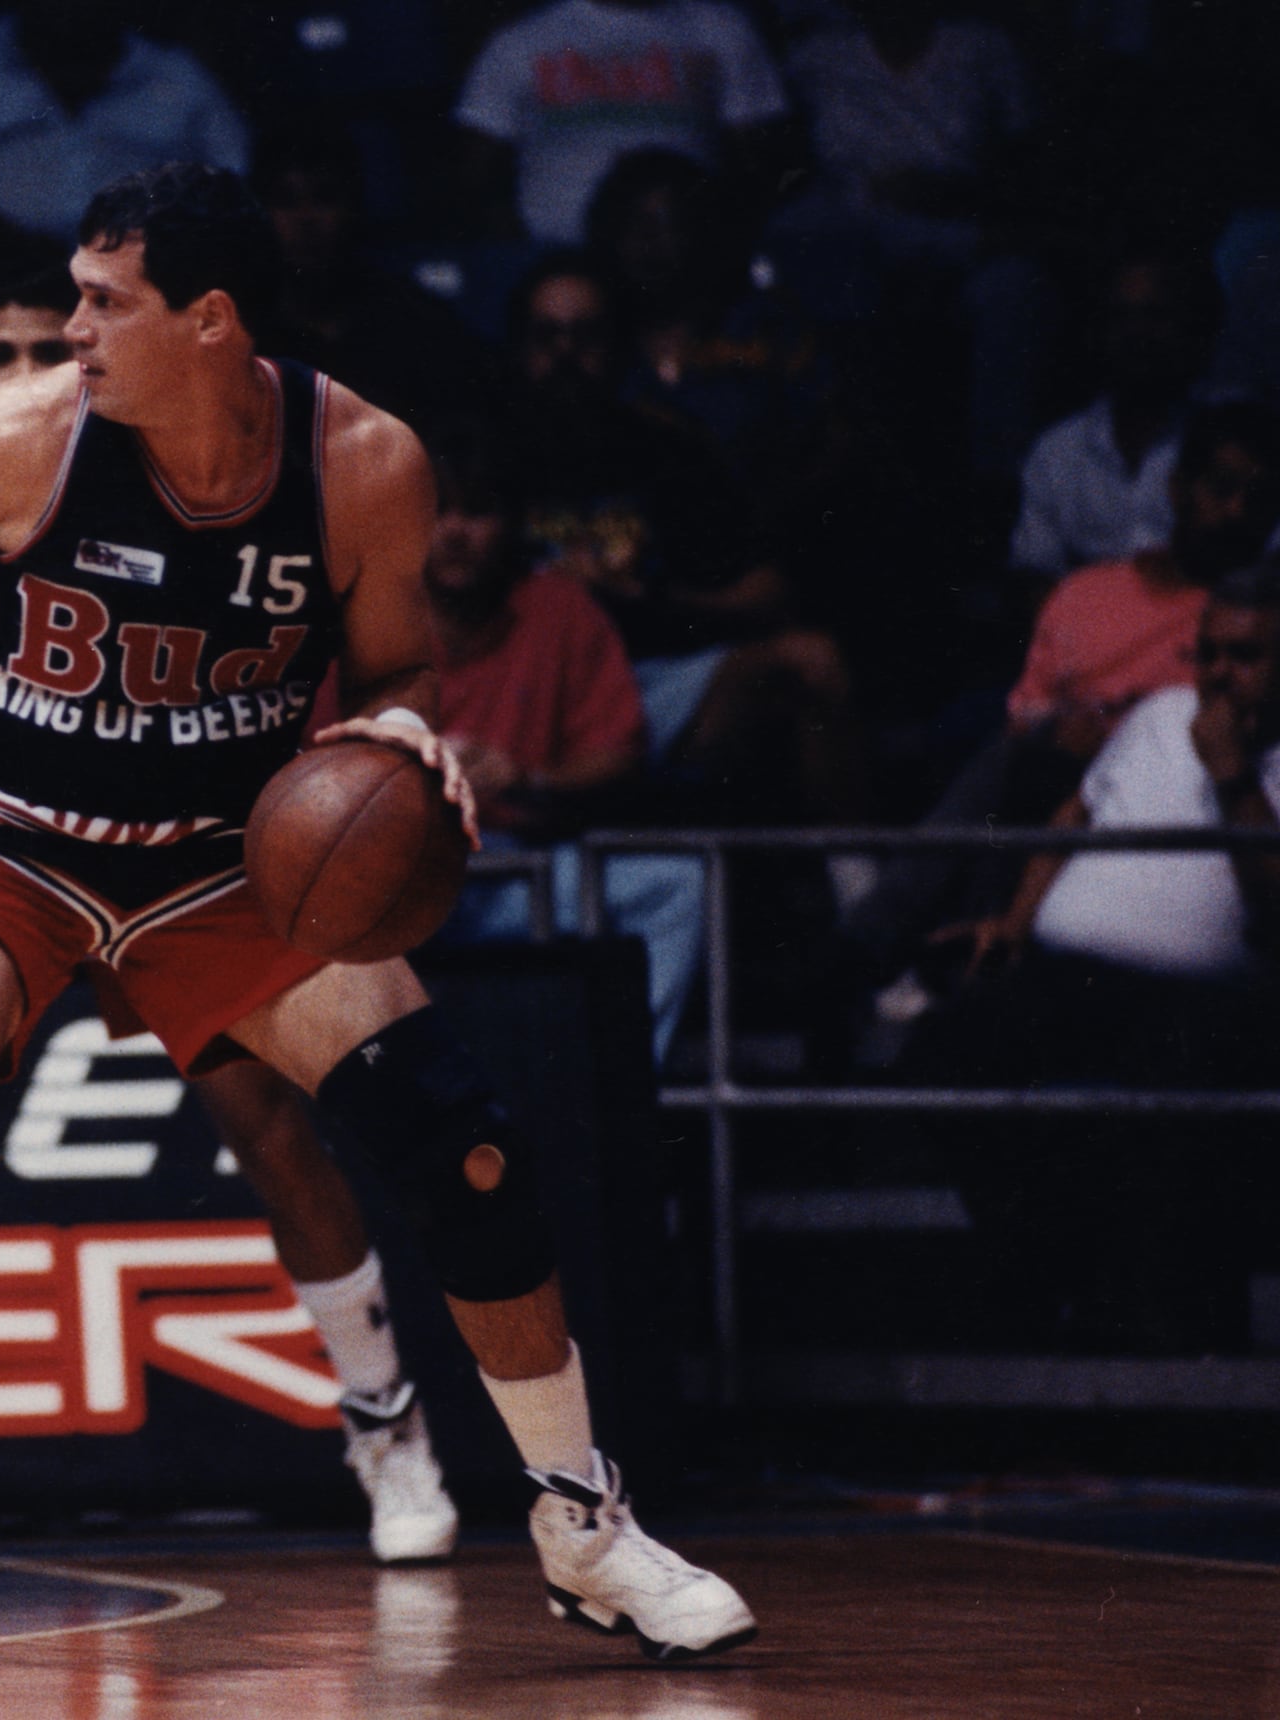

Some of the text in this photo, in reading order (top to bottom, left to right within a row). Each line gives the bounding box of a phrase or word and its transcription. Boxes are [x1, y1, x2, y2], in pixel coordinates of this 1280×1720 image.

[229, 544, 312, 614] 15
[7, 573, 308, 706] Bud
[170, 679, 310, 746] BEERS
